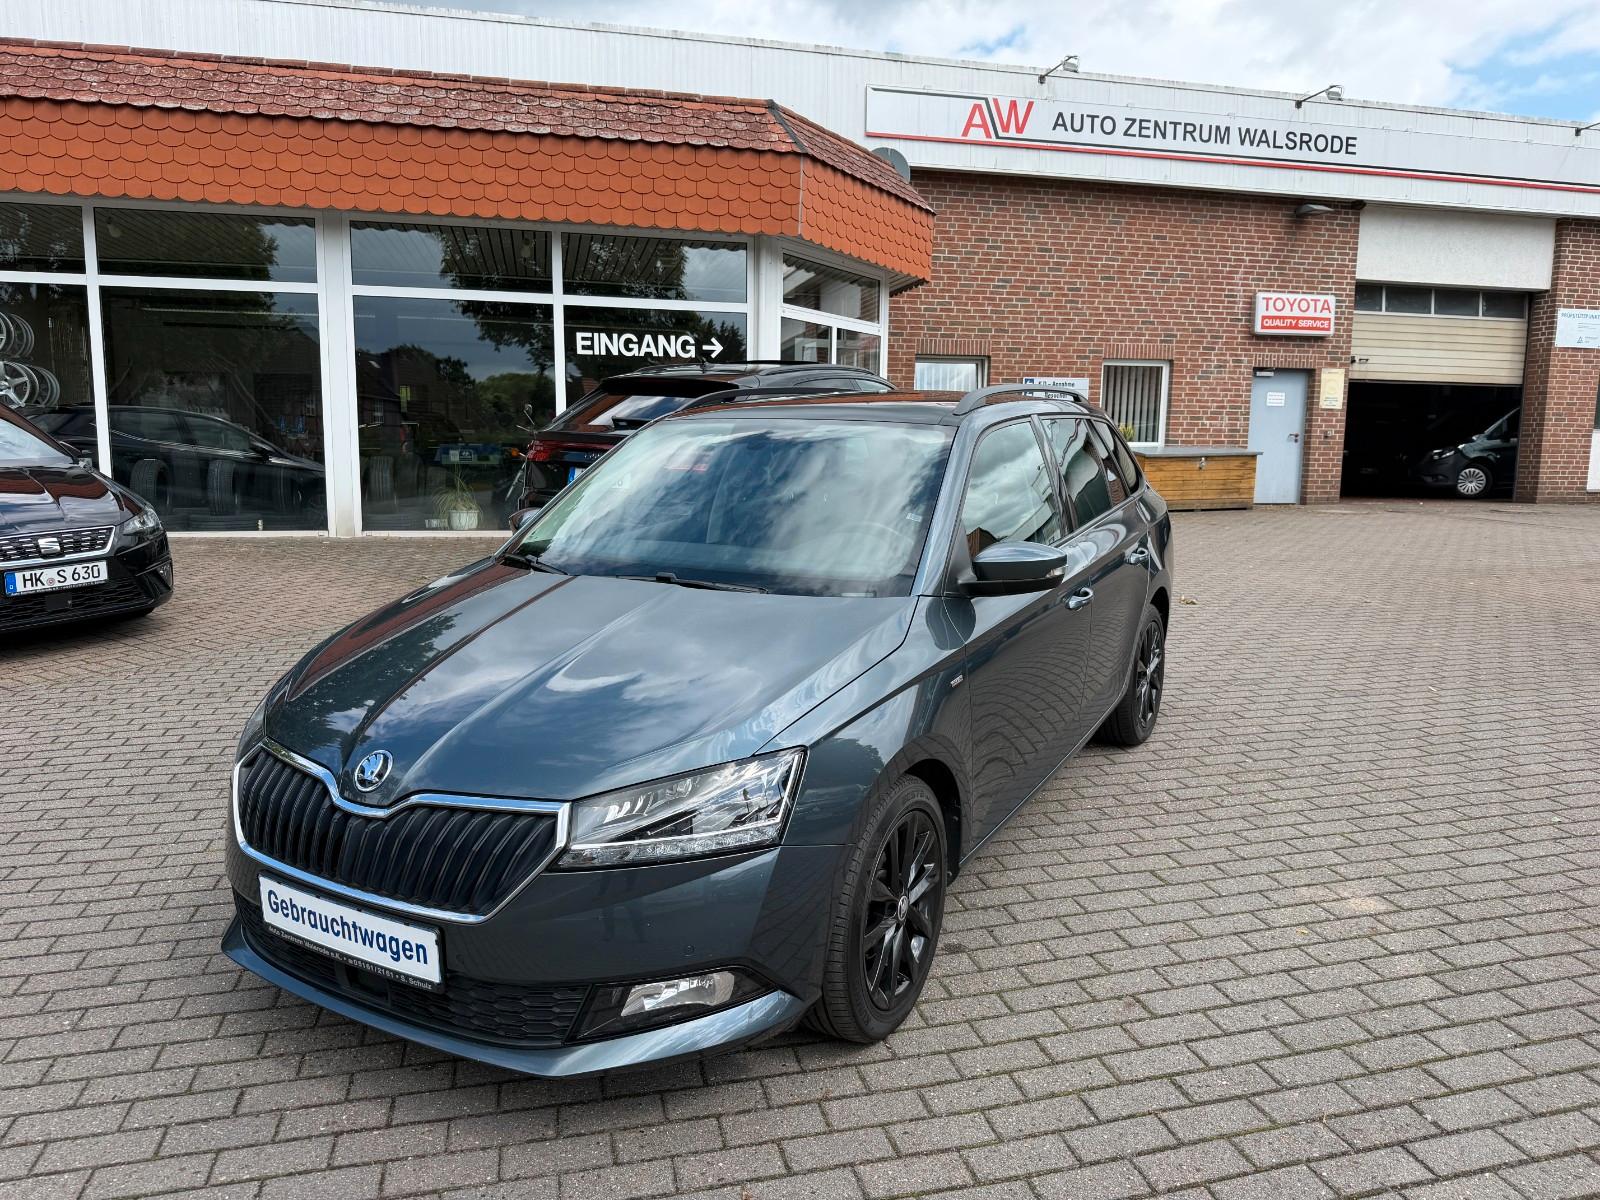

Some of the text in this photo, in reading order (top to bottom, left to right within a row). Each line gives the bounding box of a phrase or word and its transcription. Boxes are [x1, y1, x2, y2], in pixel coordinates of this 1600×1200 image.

[1052, 111, 1359, 156] AUTO ZENTRUM WALSRODE
[1262, 297, 1331, 313] TOYOTA
[1263, 318, 1330, 329] QUALITY SERVICE
[576, 331, 697, 358] EINGANG
[22, 571, 46, 589] HK
[57, 569, 67, 584] S
[71, 564, 101, 580] 630
[267, 889, 428, 965] Gebrauchtwagen
[408, 977, 432, 990] Schulz
